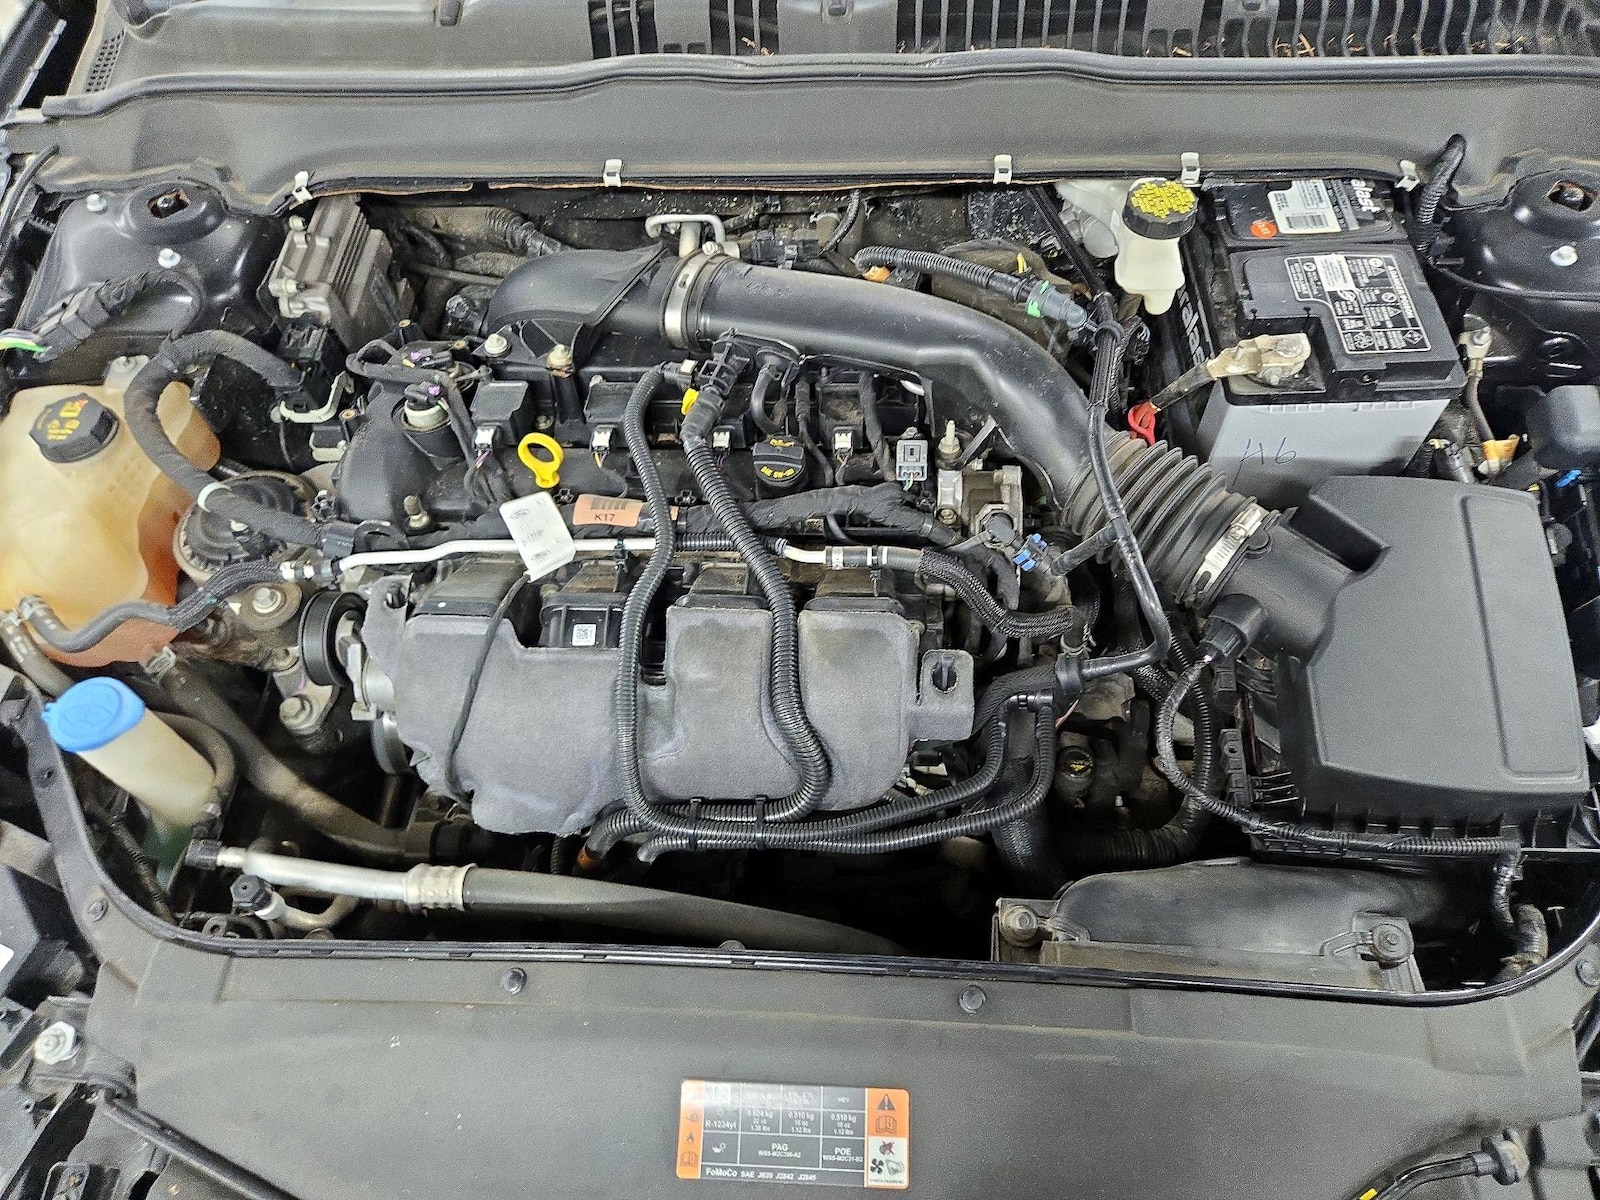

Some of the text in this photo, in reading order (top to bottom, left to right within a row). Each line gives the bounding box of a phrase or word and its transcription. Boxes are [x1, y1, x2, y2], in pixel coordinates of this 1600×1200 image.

[594, 513, 616, 521] K17
[771, 1143, 788, 1151] PAG
[834, 1147, 852, 1155] POE
[705, 1166, 738, 1177] FoMoCo
[741, 1169, 755, 1178] SAE
